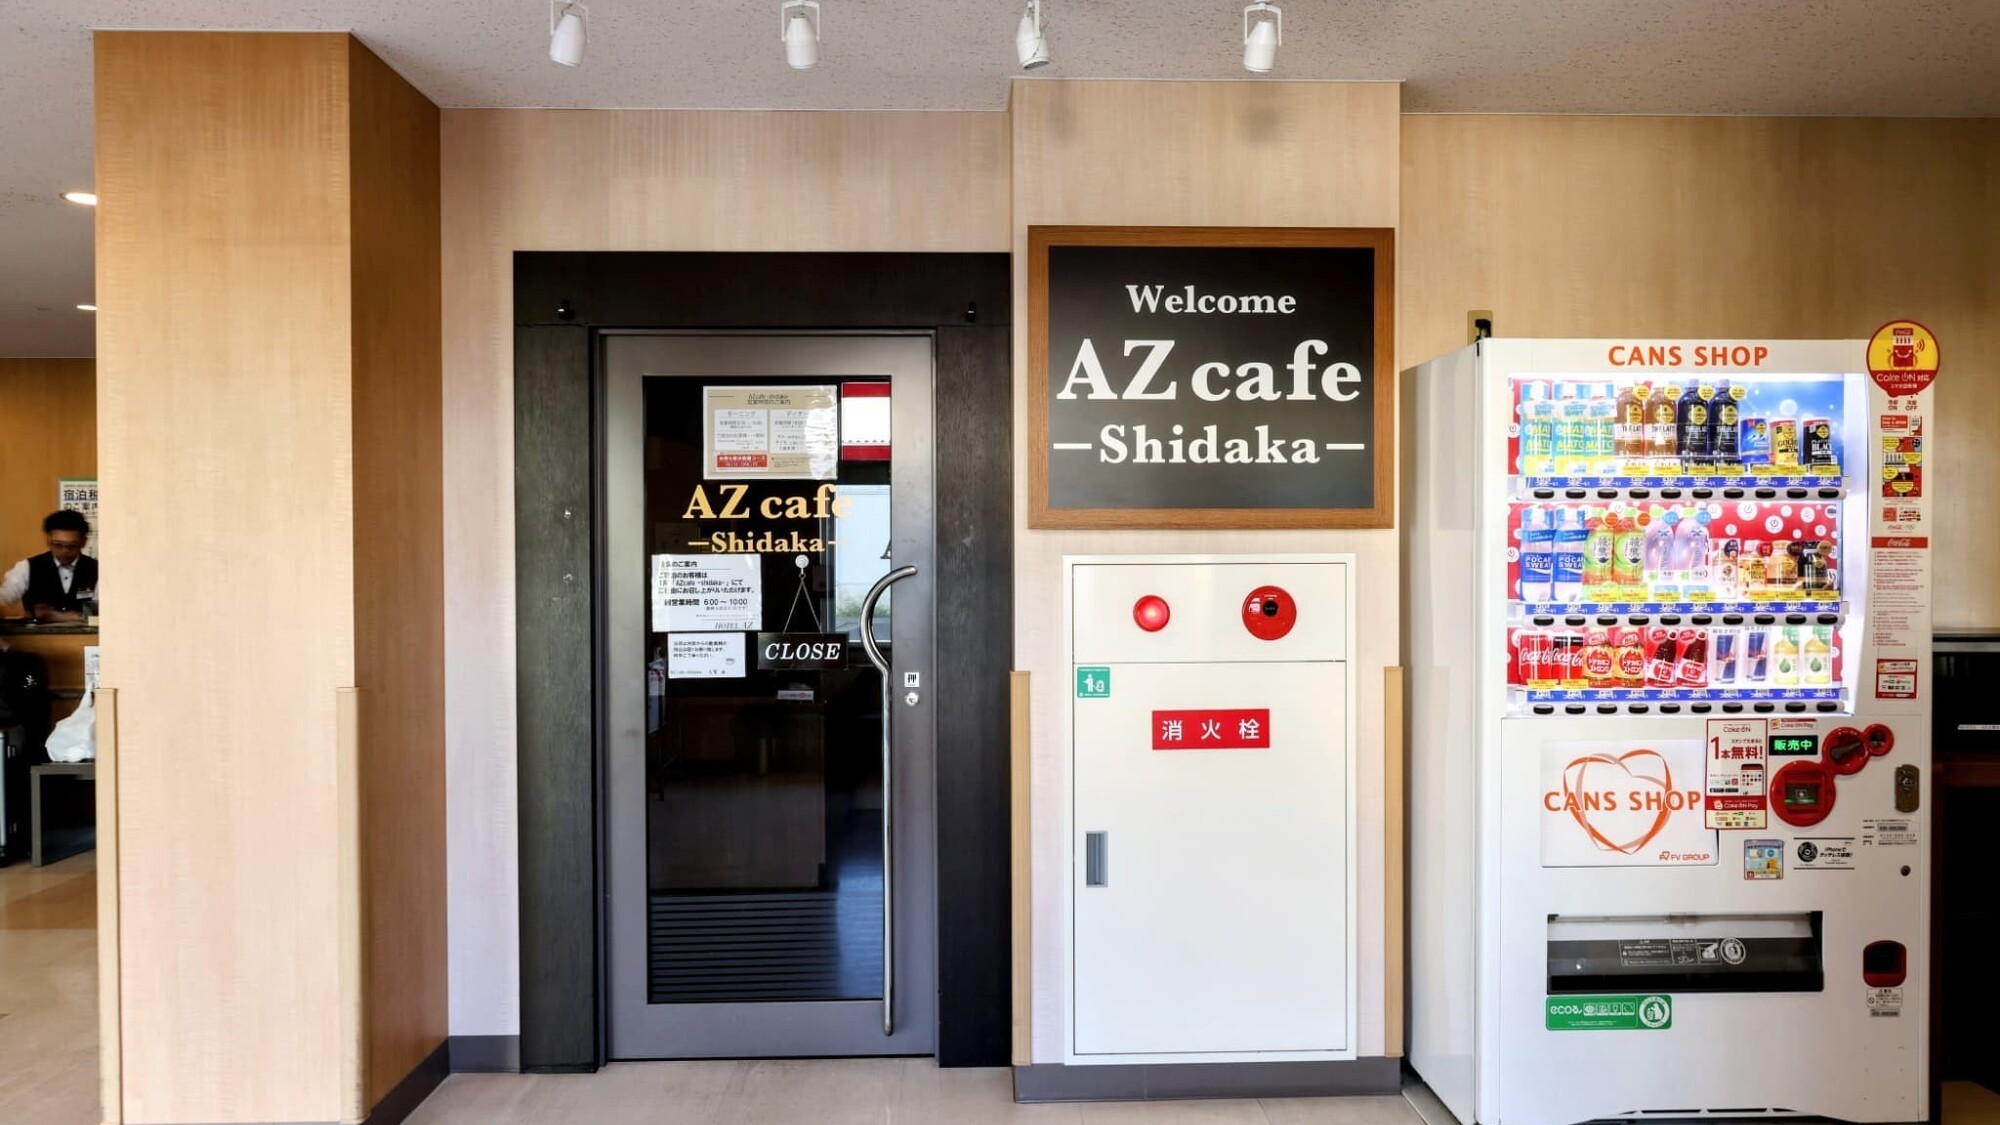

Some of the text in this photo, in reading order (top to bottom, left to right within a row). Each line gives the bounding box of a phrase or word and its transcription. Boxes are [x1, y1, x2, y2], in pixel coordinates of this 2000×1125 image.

[1125, 285, 1297, 314] Welcome
[1608, 346, 1768, 366] CANS SHOP
[1056, 338, 1362, 401] AZ cafe
[682, 484, 853, 519] AZ cafe
[765, 643, 841, 661] CLOSE
[1162, 719, 1260, 741] 消火栓
[1774, 739, 1812, 751] 販売中
[1544, 791, 1701, 811] CANS SHOP
